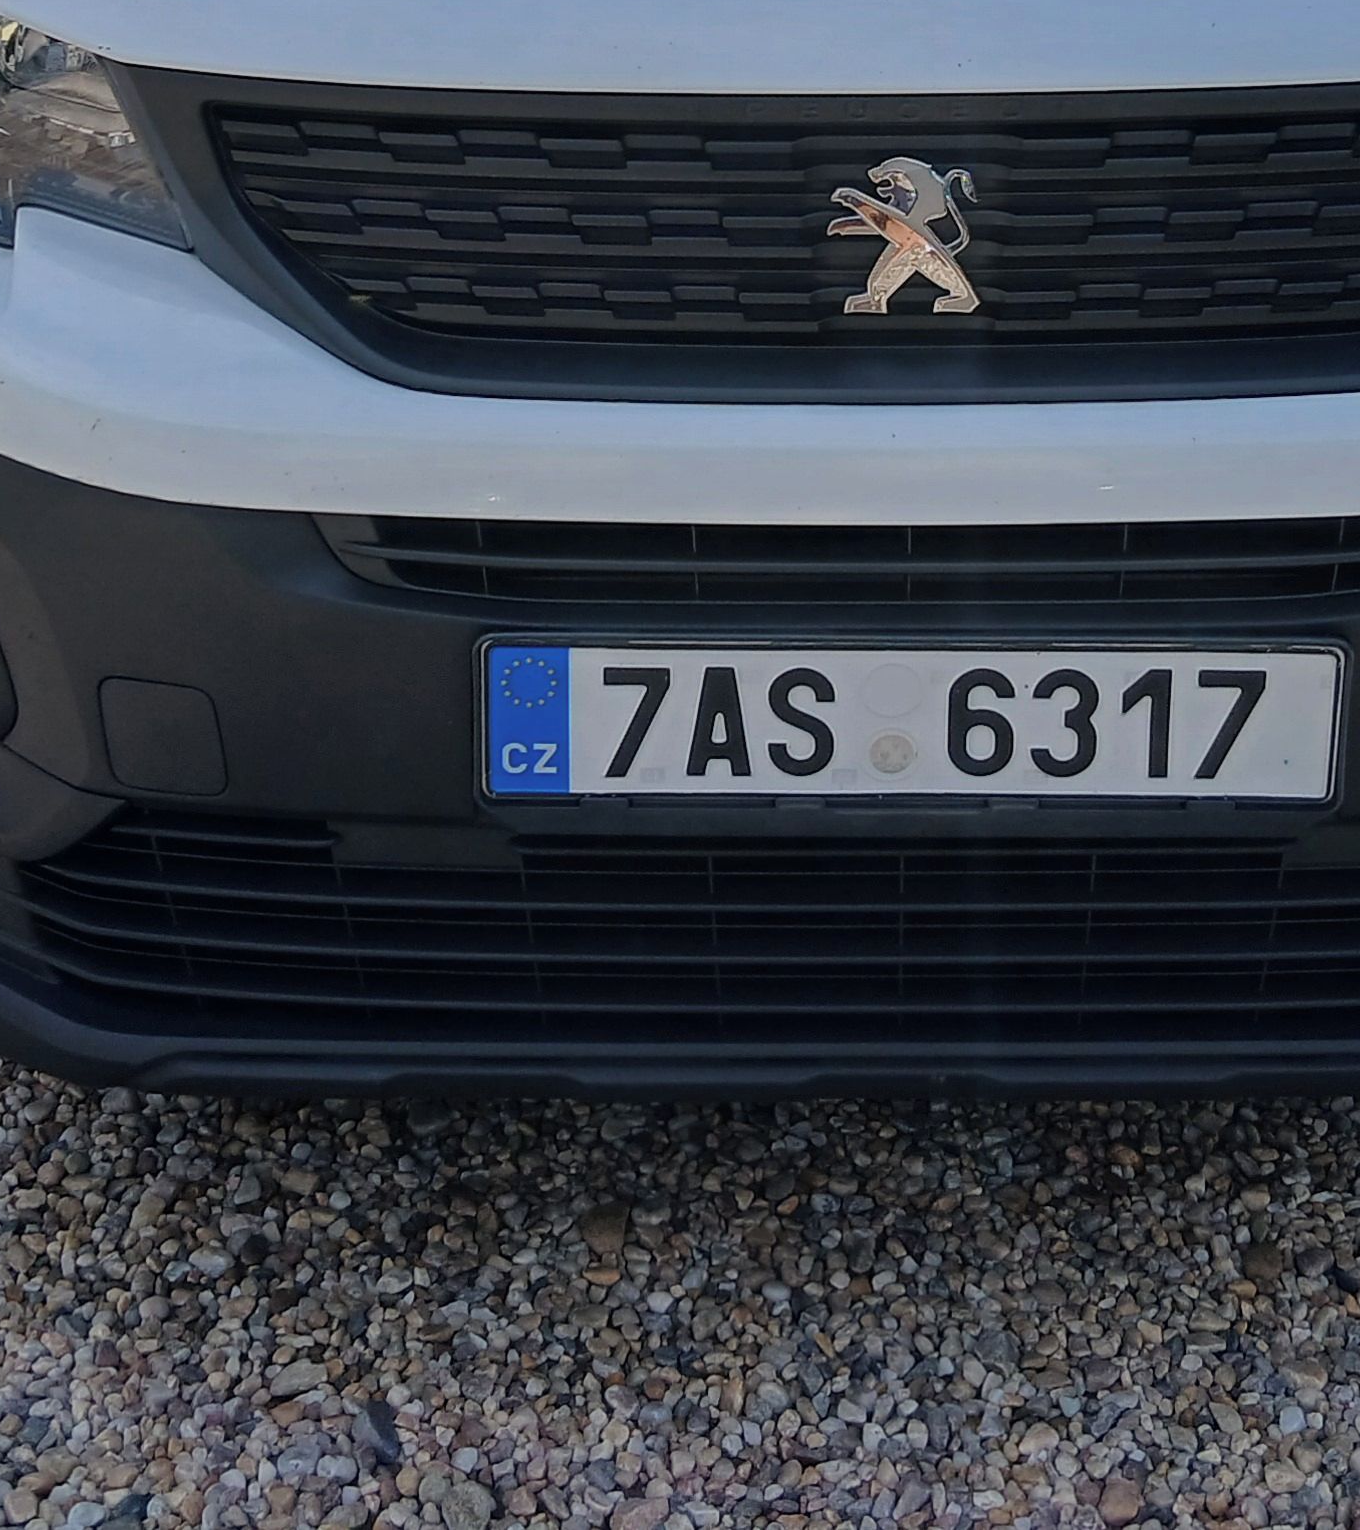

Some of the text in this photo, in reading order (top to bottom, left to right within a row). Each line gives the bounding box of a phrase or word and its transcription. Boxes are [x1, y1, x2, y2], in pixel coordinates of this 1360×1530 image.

[500, 741, 559, 776] CZ
[602, 666, 1269, 780] 7AS 6317
